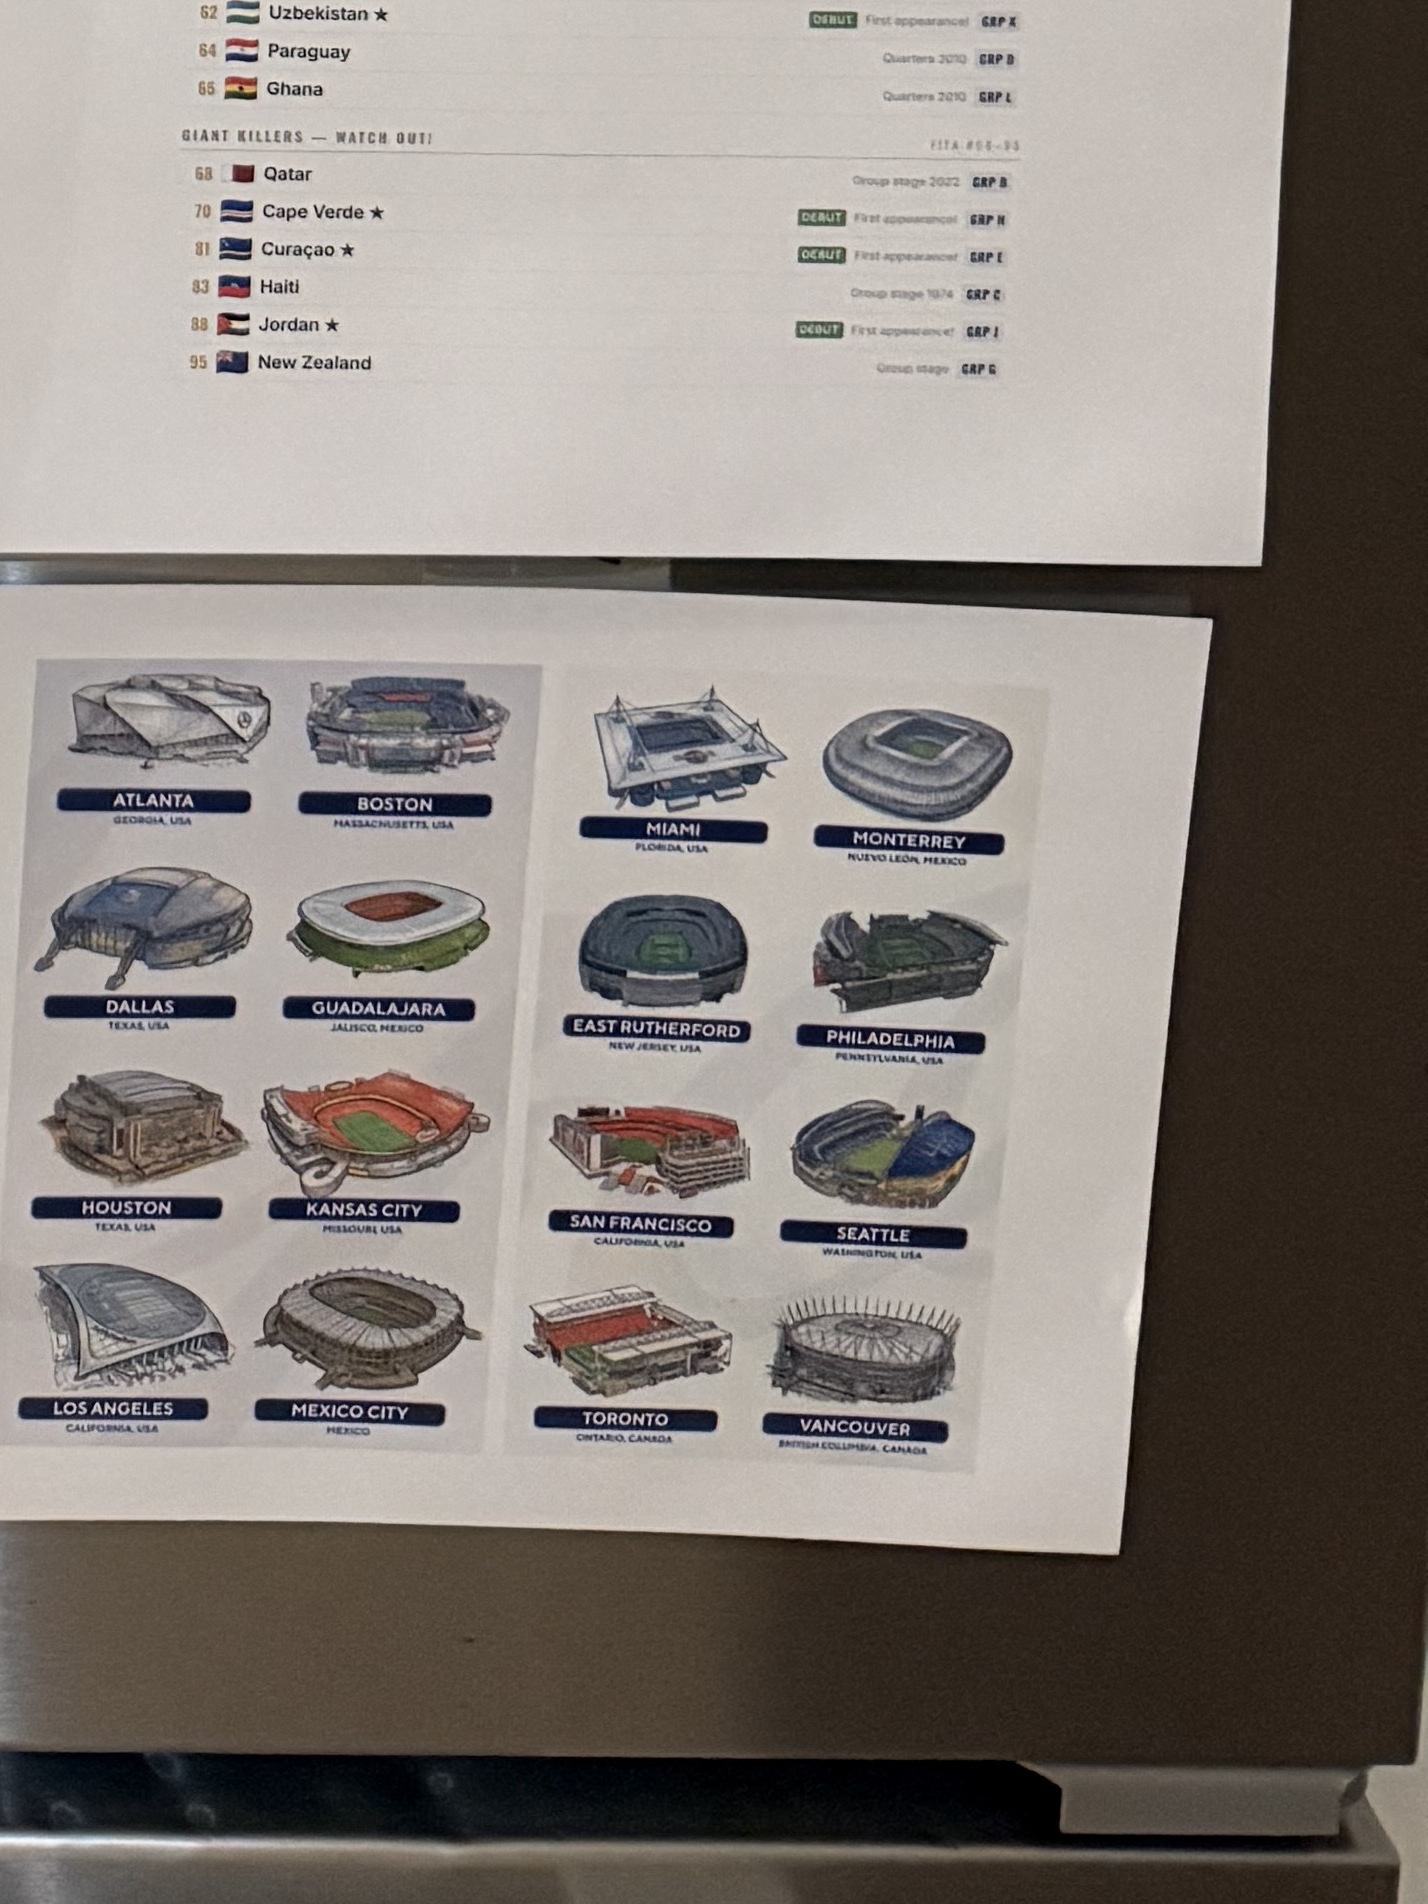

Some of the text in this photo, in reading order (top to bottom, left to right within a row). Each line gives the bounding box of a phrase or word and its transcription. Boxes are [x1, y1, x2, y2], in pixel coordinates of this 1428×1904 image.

[263, 204, 364, 222] Cape Verde
[114, 793, 193, 807] ATLANTA
[358, 797, 432, 811] BOSTON
[647, 823, 700, 836] MIAMI
[853, 831, 966, 851] MONTERREY
[107, 1000, 174, 1013] DALLAS
[312, 1001, 445, 1016] GUADALAJARA
[573, 1018, 741, 1039] EAST RUTHERFORD
[827, 1030, 956, 1049] PHILADELPHIA
[837, 1226, 911, 1243] SEATTLE
[292, 1404, 408, 1419] MEXICO CITY
[800, 1418, 911, 1437] VANCOUVER
